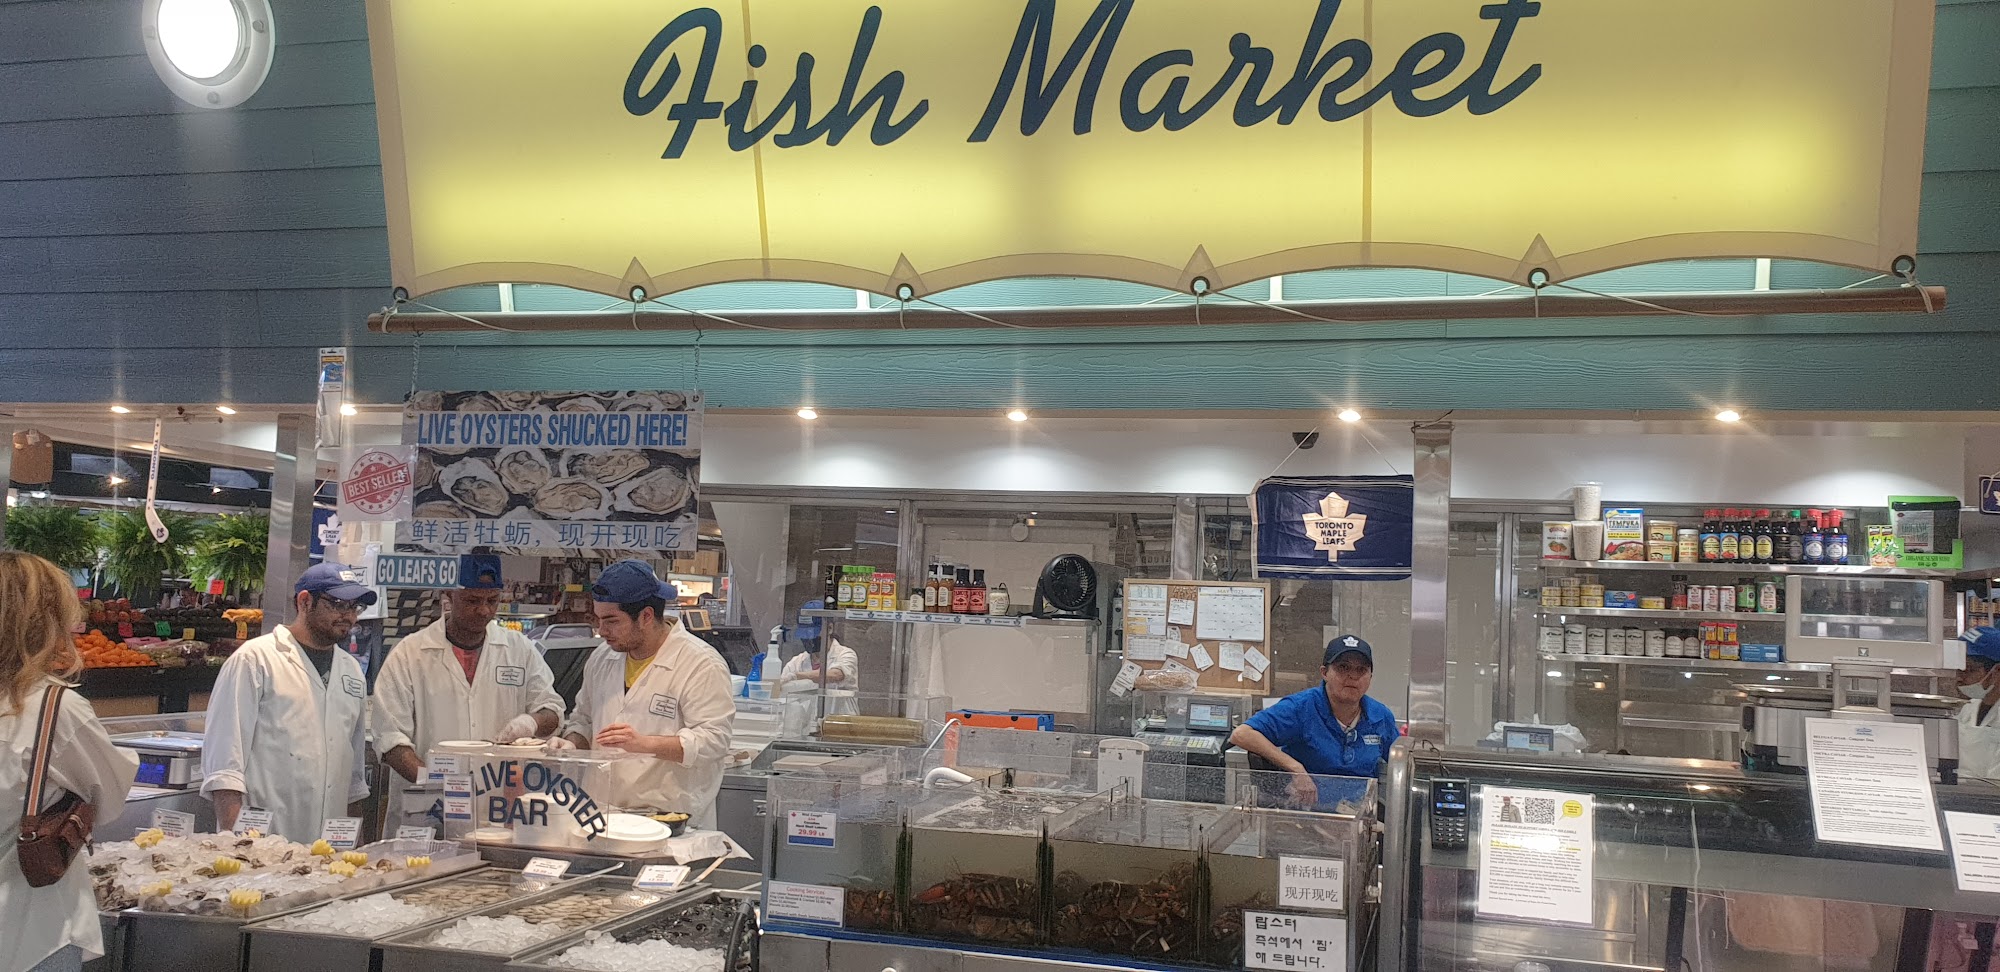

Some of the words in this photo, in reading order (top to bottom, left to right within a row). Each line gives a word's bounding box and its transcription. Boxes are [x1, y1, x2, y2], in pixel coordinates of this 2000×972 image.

[624, 7, 928, 158] Fish
[966, 0, 1541, 142] Market
[418, 413, 458, 445] LIVE
[461, 413, 543, 446] OYSTERS
[548, 413, 631, 447] SHUCKED
[636, 413, 688, 446] HERE!
[348, 479, 371, 498] BEST
[1315, 522, 1354, 530] TORONTO
[1323, 537, 1346, 545] LEAFS
[378, 558, 395, 583] GO
[397, 559, 436, 584] LEAFS
[440, 560, 457, 585] GO
[470, 760, 518, 797] LIVE
[523, 762, 607, 842] OYSTER
[489, 796, 548, 826] BAR
[1284, 864, 1338, 881] 鲜活牡蛎
[1284, 886, 1338, 903] 现开现吃
[1255, 916, 1296, 932] 랍스터
[1255, 935, 1302, 950] 즉석에서
[1255, 952, 1266, 963] 해
[1272, 953, 1325, 968] 드립니다.
